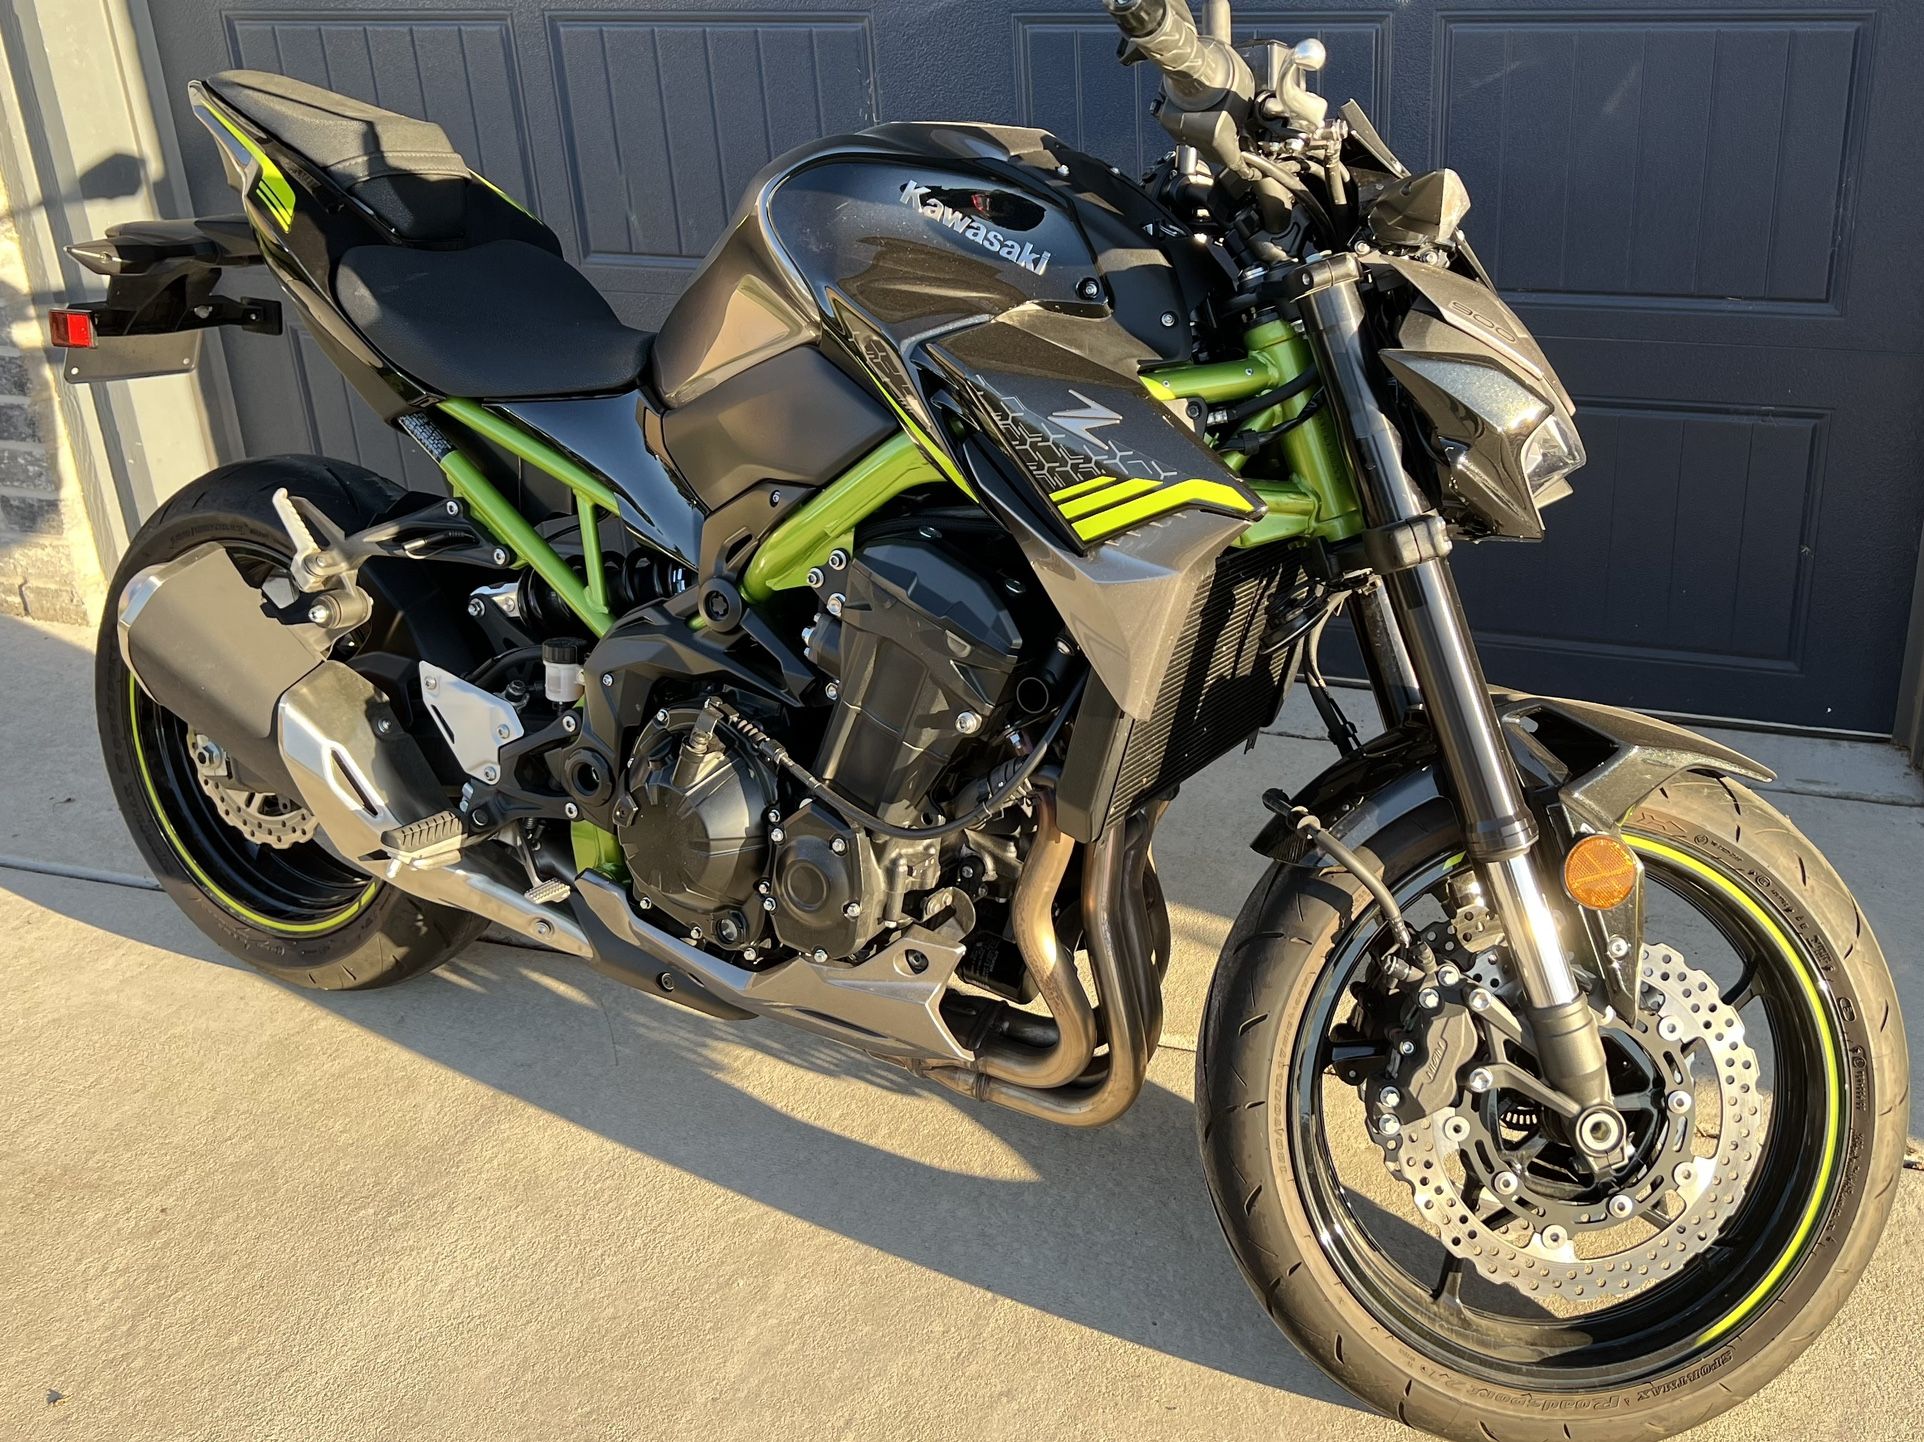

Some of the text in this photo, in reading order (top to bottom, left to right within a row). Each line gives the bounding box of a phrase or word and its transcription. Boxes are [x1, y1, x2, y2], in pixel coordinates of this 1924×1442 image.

[899, 179, 1051, 276] Kawasaki
[1450, 301, 1516, 343] 900
[1637, 1350, 1734, 1402] SPORTMAX
